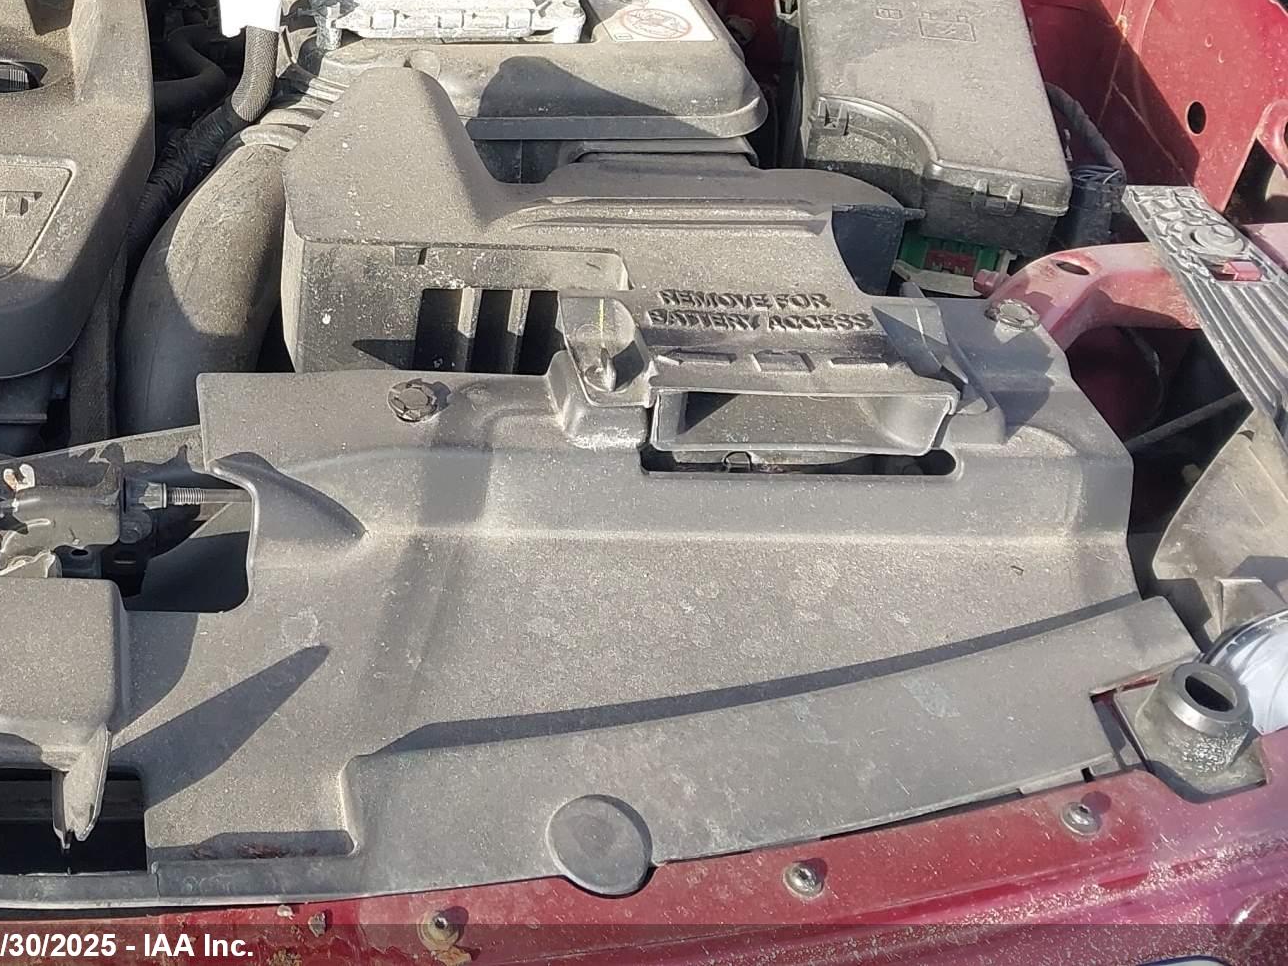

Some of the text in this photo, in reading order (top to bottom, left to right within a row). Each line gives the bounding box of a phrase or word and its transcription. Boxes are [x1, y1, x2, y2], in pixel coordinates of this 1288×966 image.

[658, 289, 832, 310] REMOVE FOR
[646, 308, 875, 331] BATTERY ACCESS
